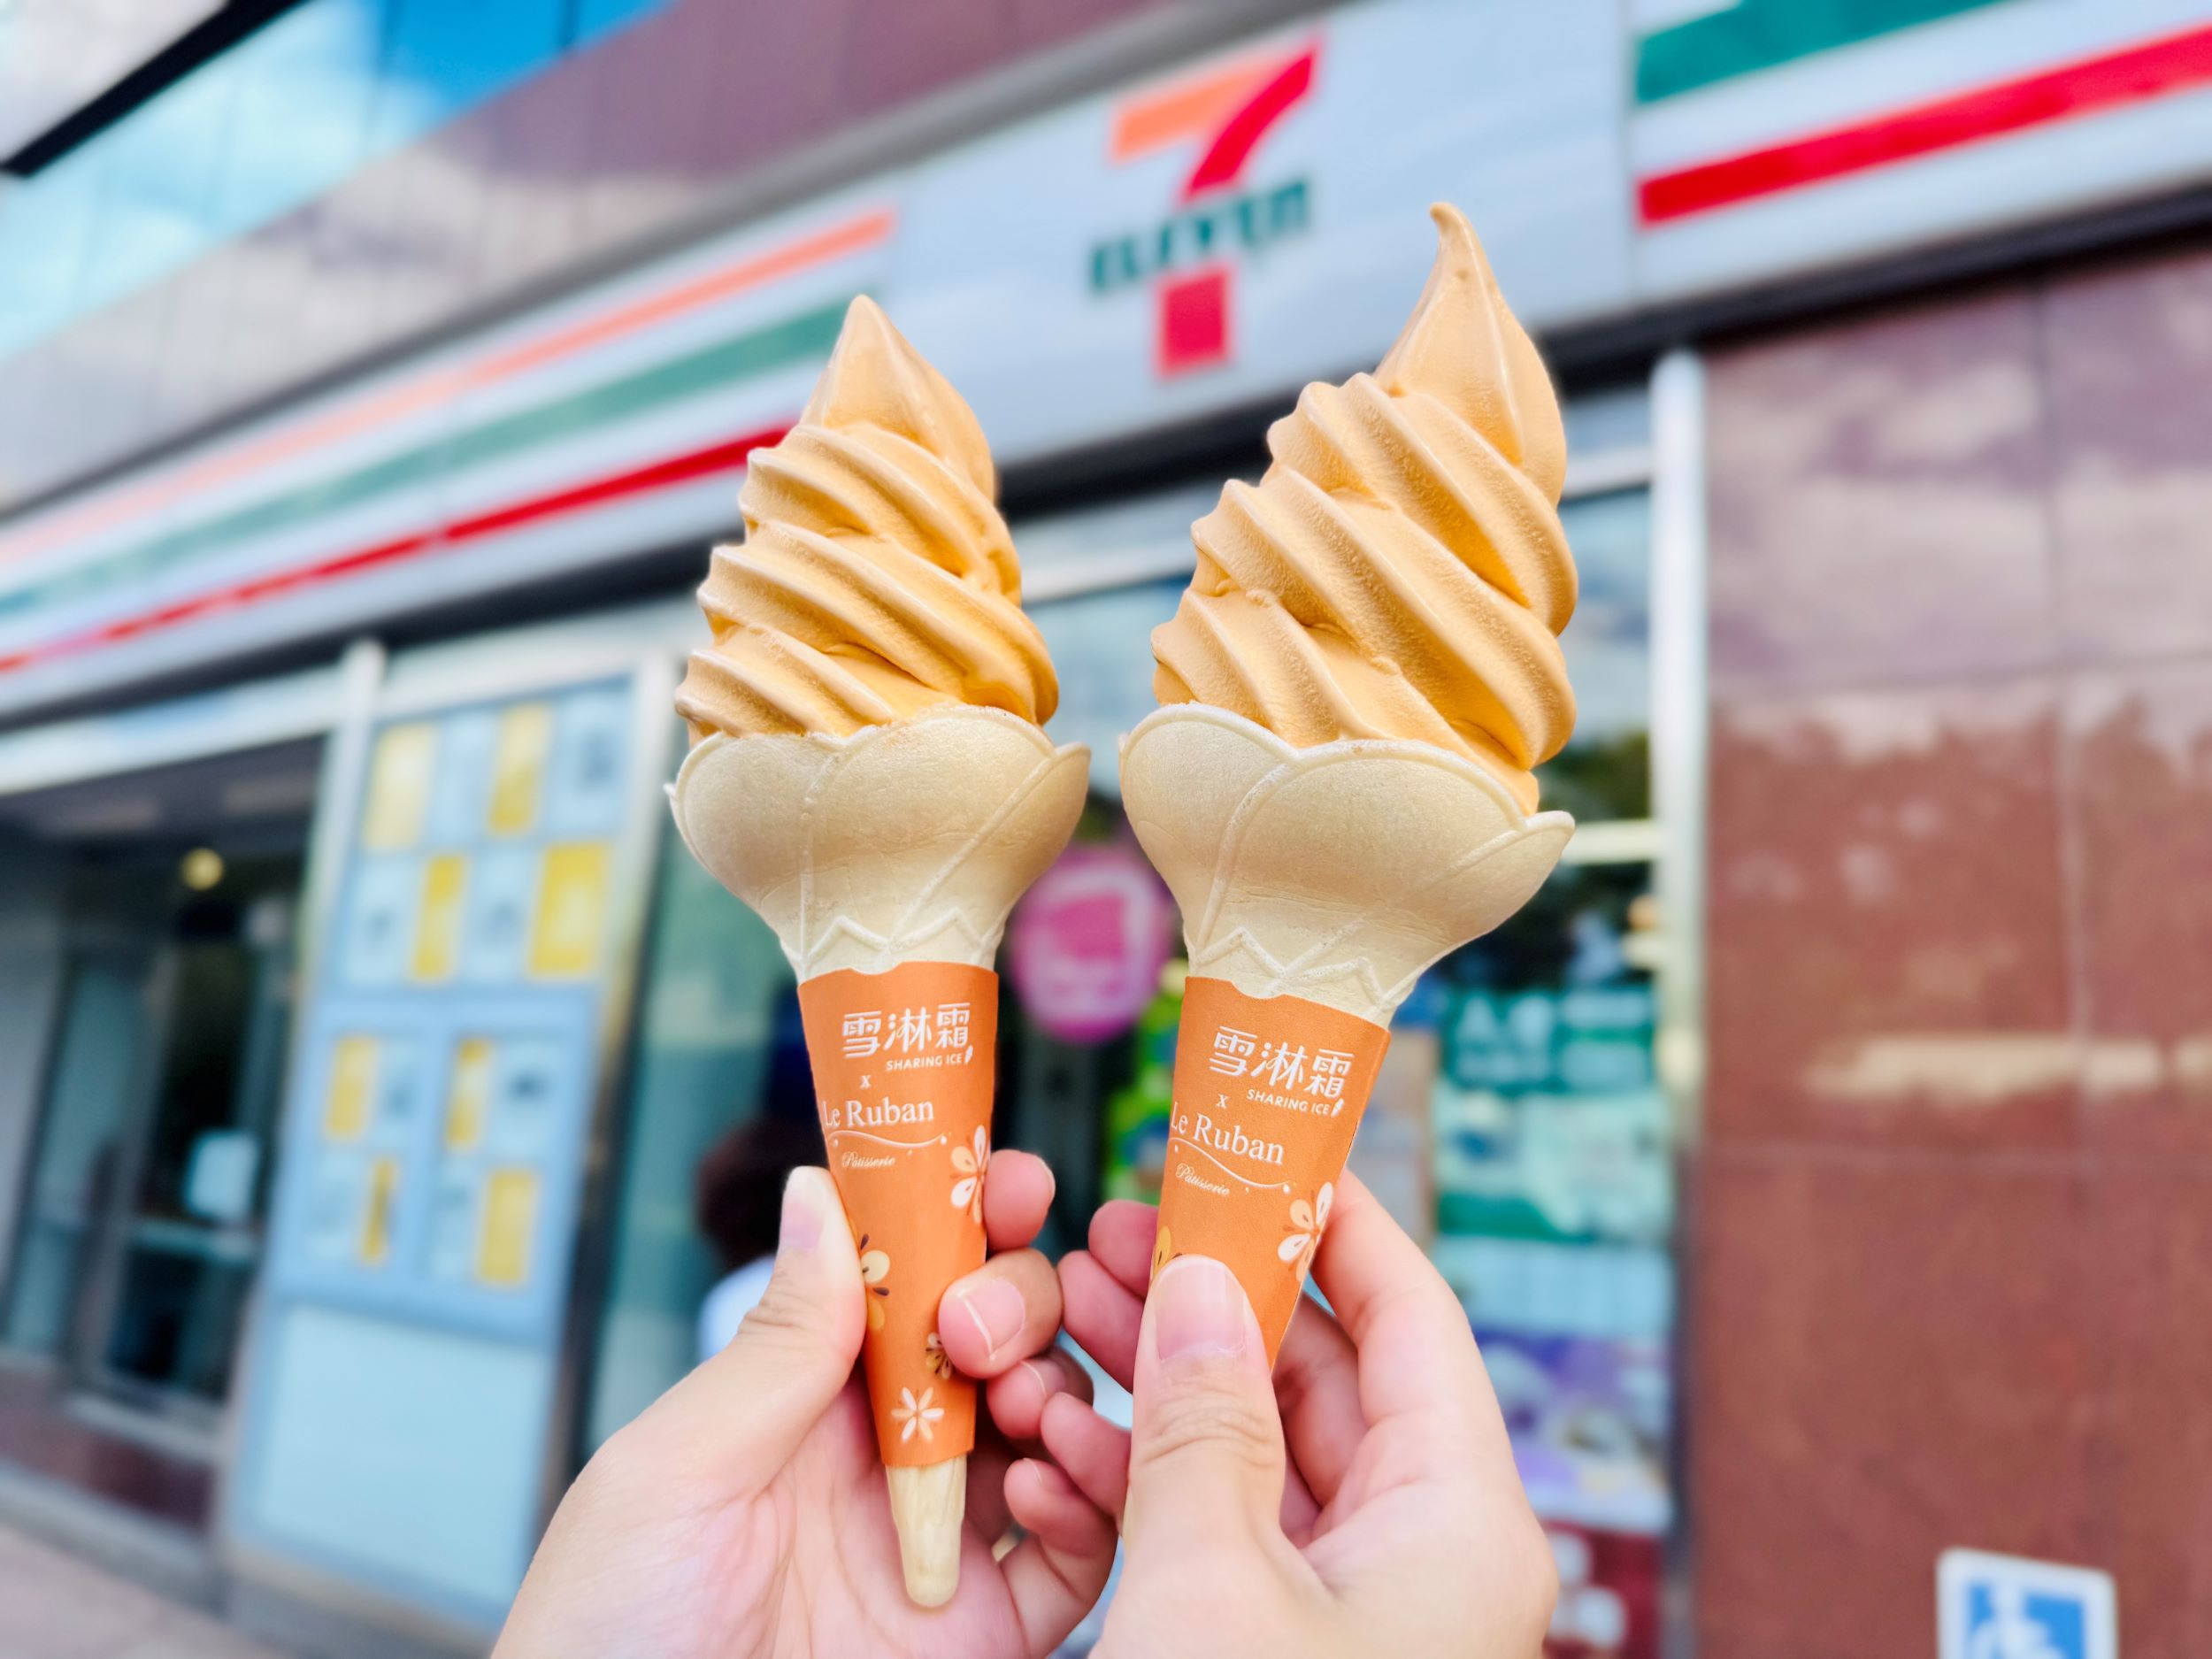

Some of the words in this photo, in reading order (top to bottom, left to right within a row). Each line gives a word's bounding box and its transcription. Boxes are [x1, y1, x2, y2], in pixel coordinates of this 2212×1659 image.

[842, 1002, 971, 1059] 雪淋霜
[886, 1056, 942, 1071] SHARING
[946, 1052, 963, 1065] ICE
[1209, 1025, 1355, 1100] 雪淋霜
[823, 1101, 841, 1127] Le
[846, 1097, 934, 1127] Ruban
[1247, 1088, 1309, 1112] SHARING
[1310, 1102, 1331, 1115] ICE
[1171, 1101, 1188, 1134] Le
[1194, 1112, 1284, 1165] Ruban
